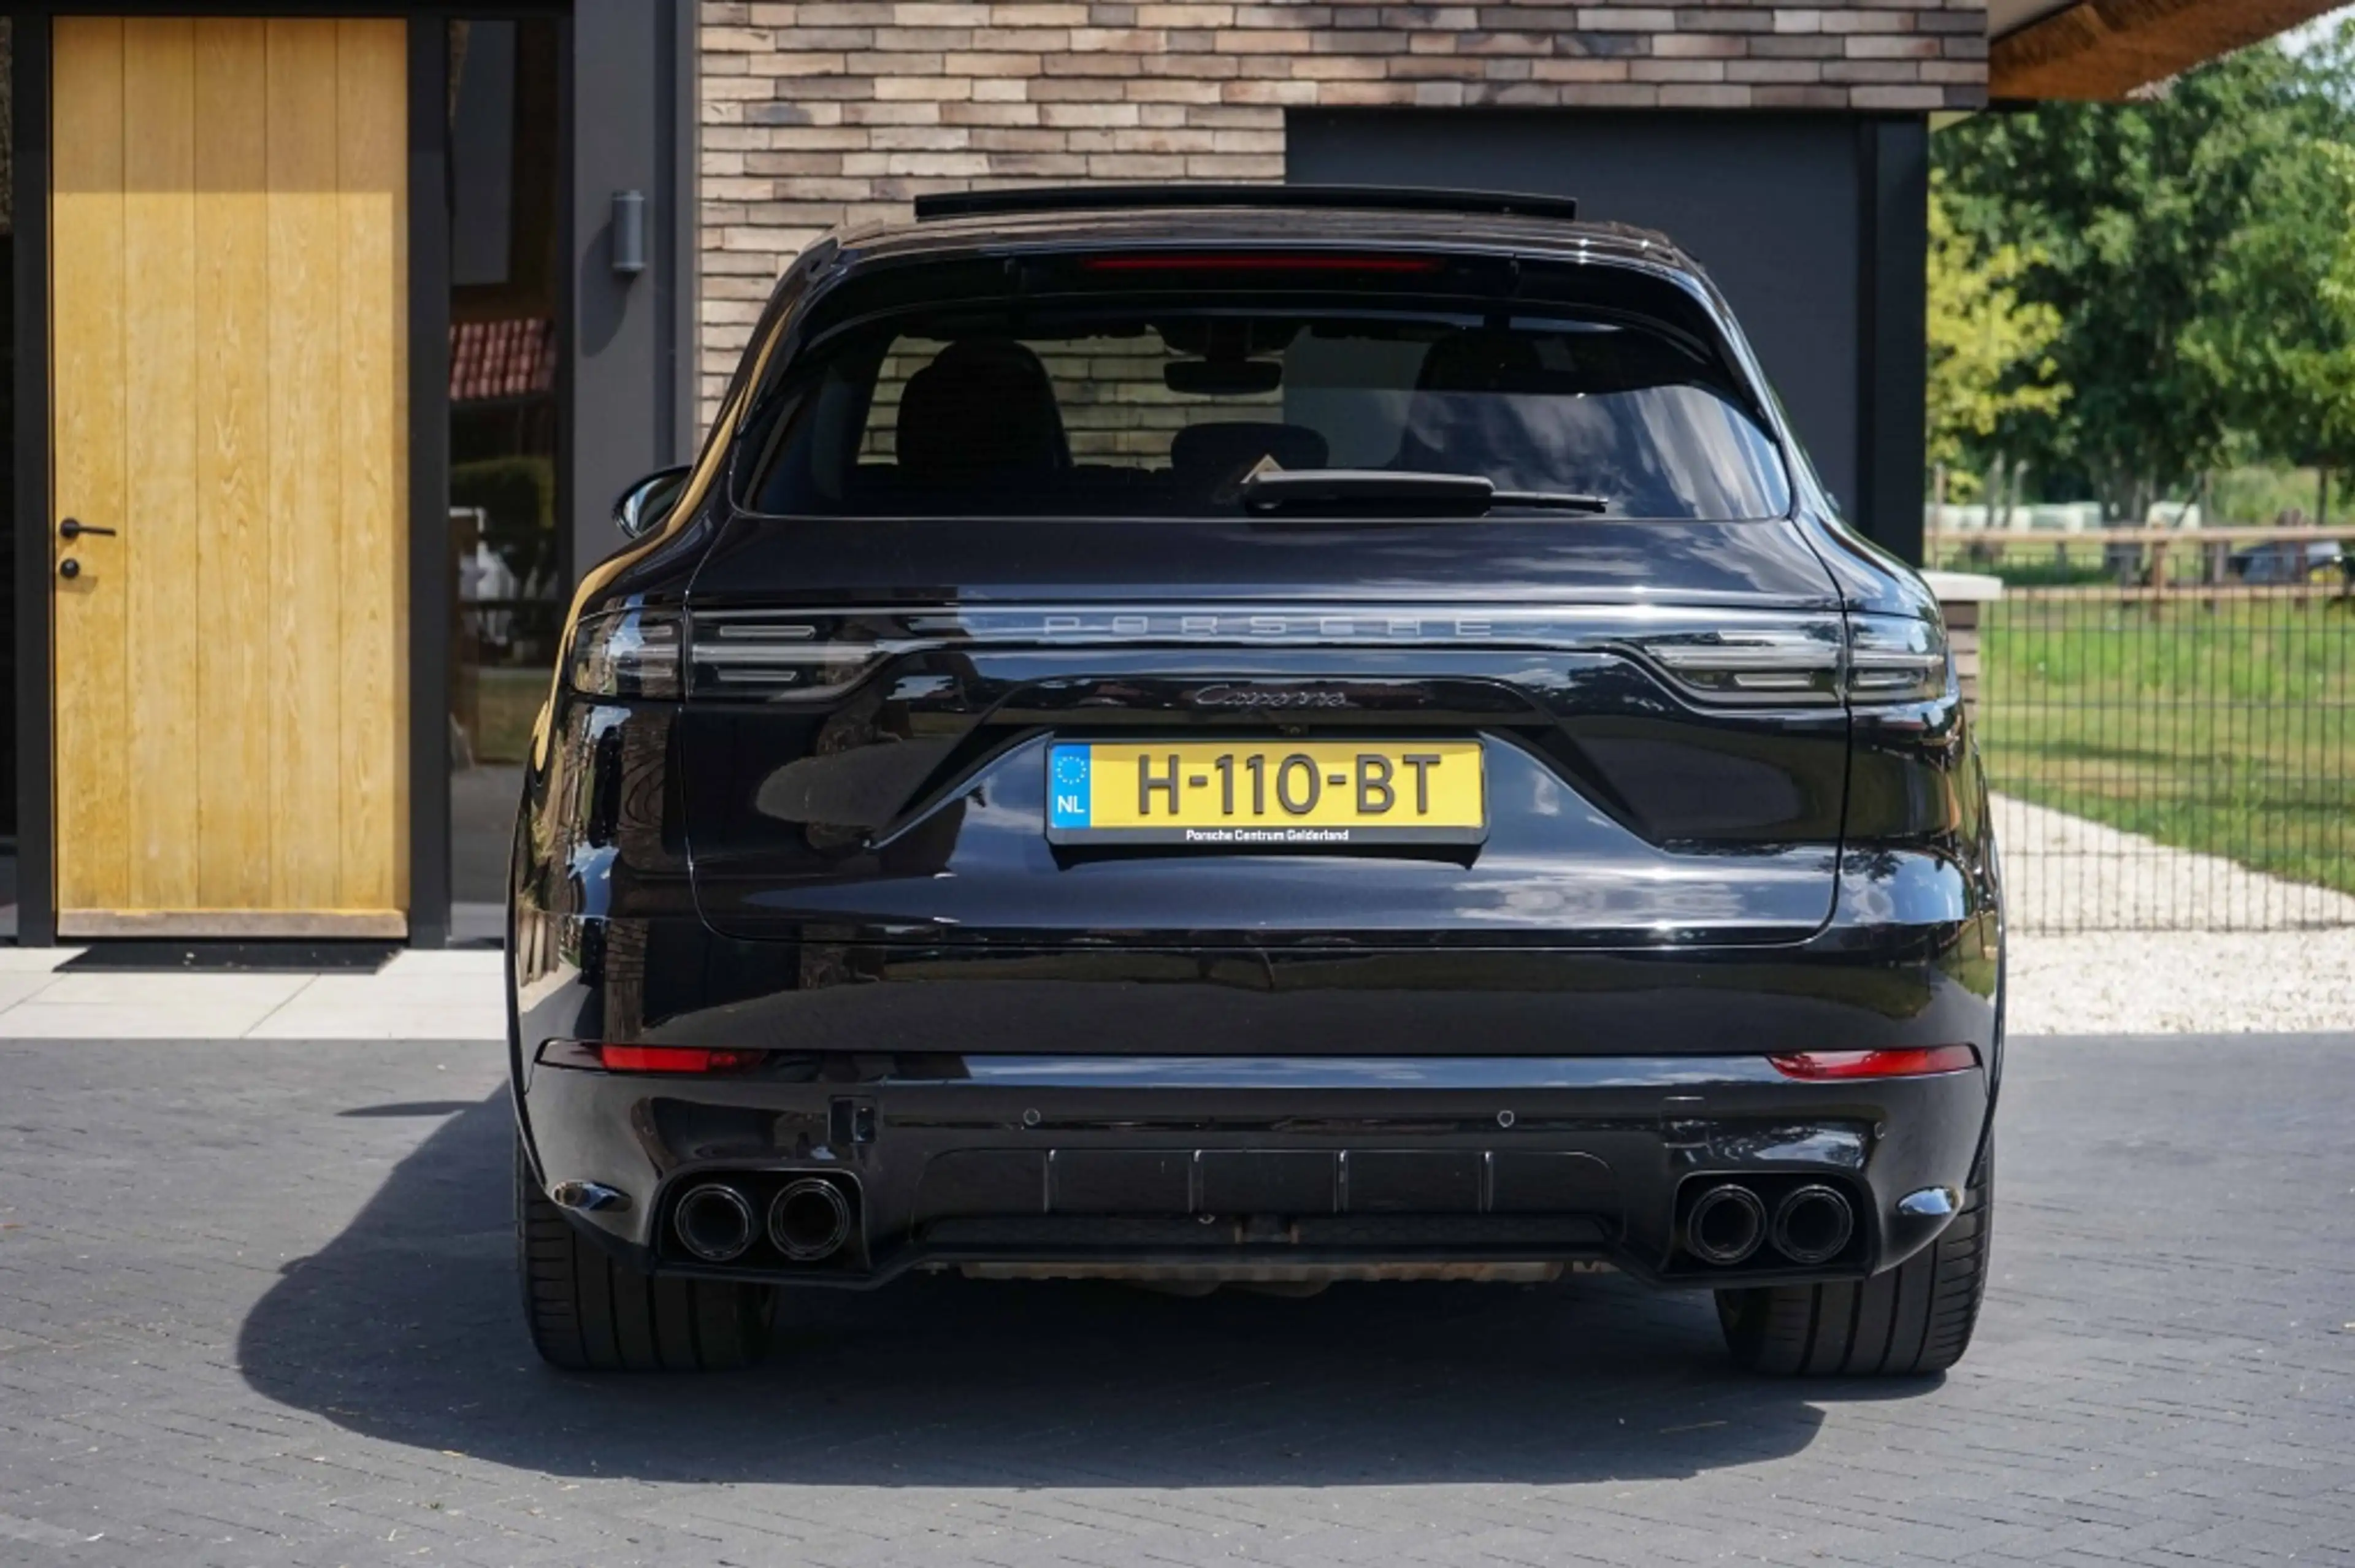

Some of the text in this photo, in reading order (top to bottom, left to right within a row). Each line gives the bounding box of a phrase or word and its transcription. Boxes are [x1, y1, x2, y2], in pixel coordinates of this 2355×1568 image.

[1044, 616, 1492, 635] PORSCHE
[1138, 754, 1441, 815] H-110-BT
[1057, 795, 1084, 814] NL
[1186, 829, 1349, 841] Porsche Centrum Gelderland
